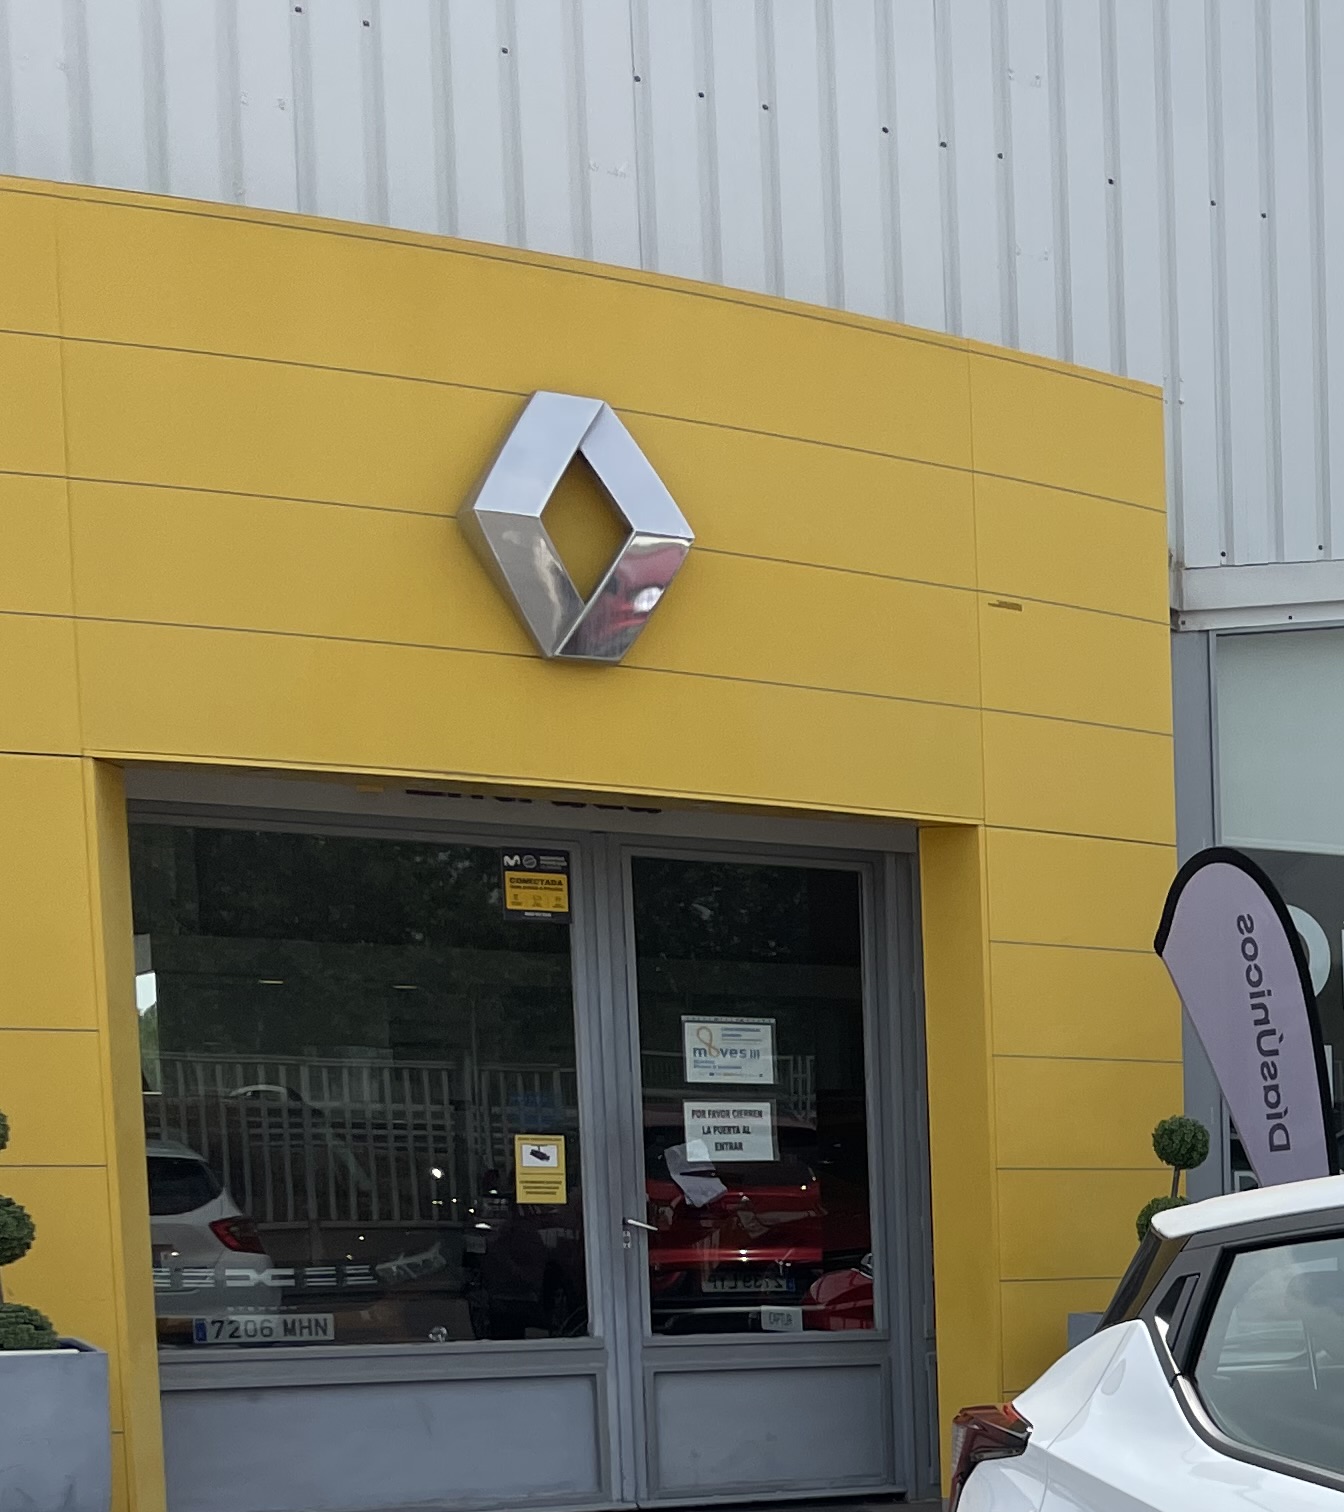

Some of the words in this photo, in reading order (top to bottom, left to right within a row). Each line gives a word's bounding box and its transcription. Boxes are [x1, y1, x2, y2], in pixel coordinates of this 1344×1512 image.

[691, 1109, 706, 1119] POR
[708, 1109, 730, 1119] FAVOR
[702, 1125, 712, 1135] LA
[713, 1125, 741, 1134] PUERTA
[742, 1125, 751, 1134] AL
[714, 1141, 743, 1151] ENTRAR
[210, 1319, 275, 1340] 7206
[282, 1317, 329, 1338] MHN
